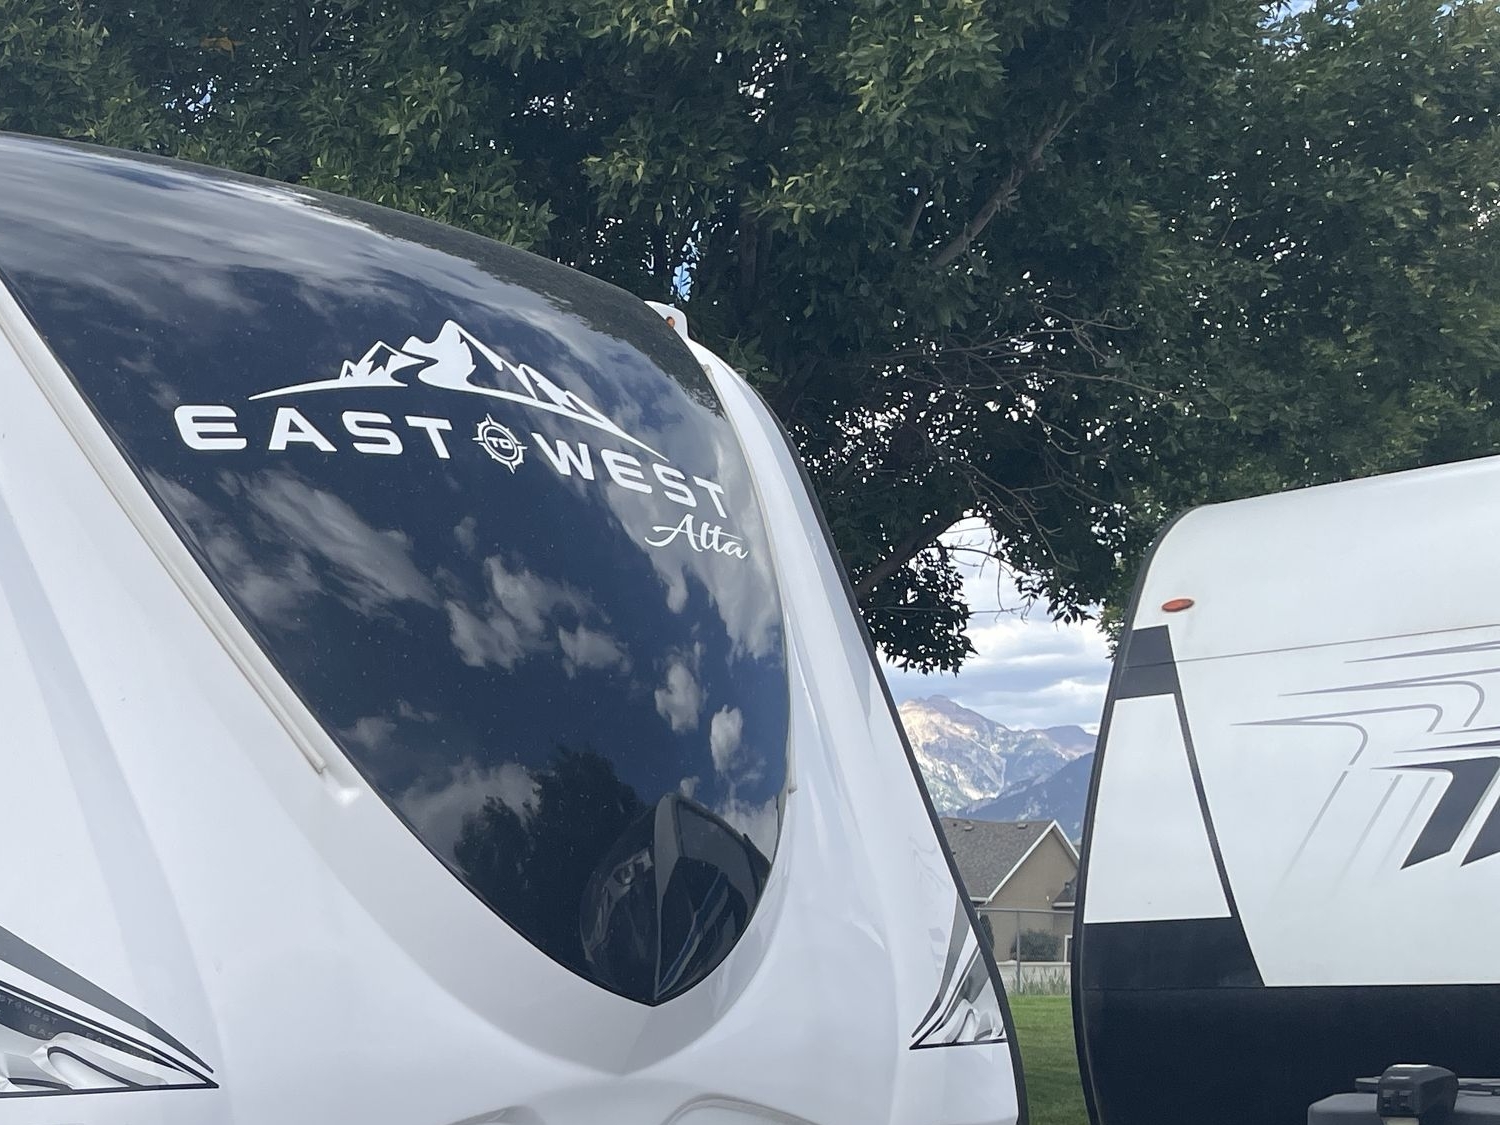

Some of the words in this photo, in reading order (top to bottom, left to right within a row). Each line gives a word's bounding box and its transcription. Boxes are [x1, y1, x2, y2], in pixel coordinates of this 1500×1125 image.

[173, 404, 452, 459] EAST
[531, 432, 726, 518] WEST
[644, 512, 748, 560] Alta
